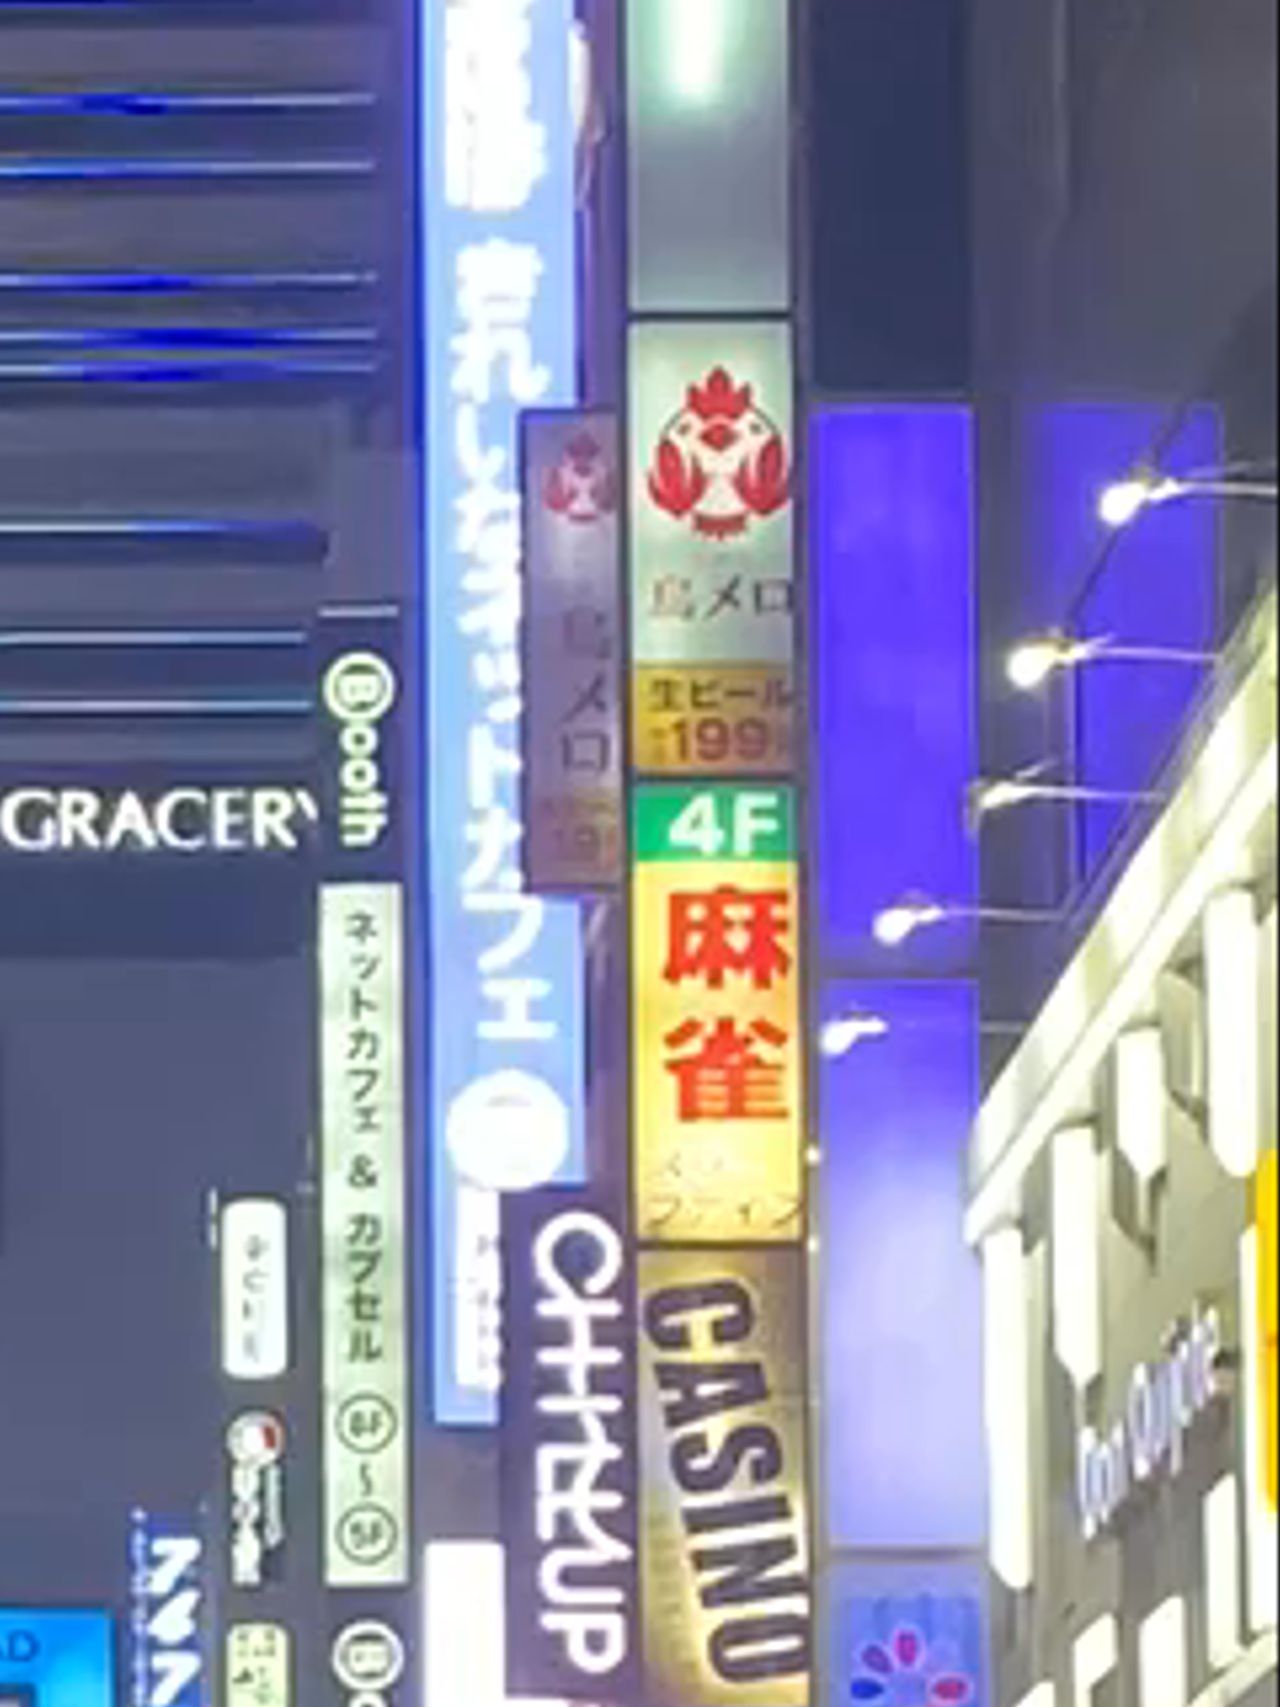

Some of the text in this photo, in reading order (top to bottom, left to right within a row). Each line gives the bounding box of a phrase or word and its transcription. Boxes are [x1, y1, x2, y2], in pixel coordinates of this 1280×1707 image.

[668, 791, 780, 857] 4F
[345, 910, 381, 1134] ネットカフェ
[661, 885, 791, 1123] 麻雀
[346, 1153, 378, 1190] &
[346, 1213, 383, 1365] カプセル
[643, 1278, 812, 1684] CASINO
